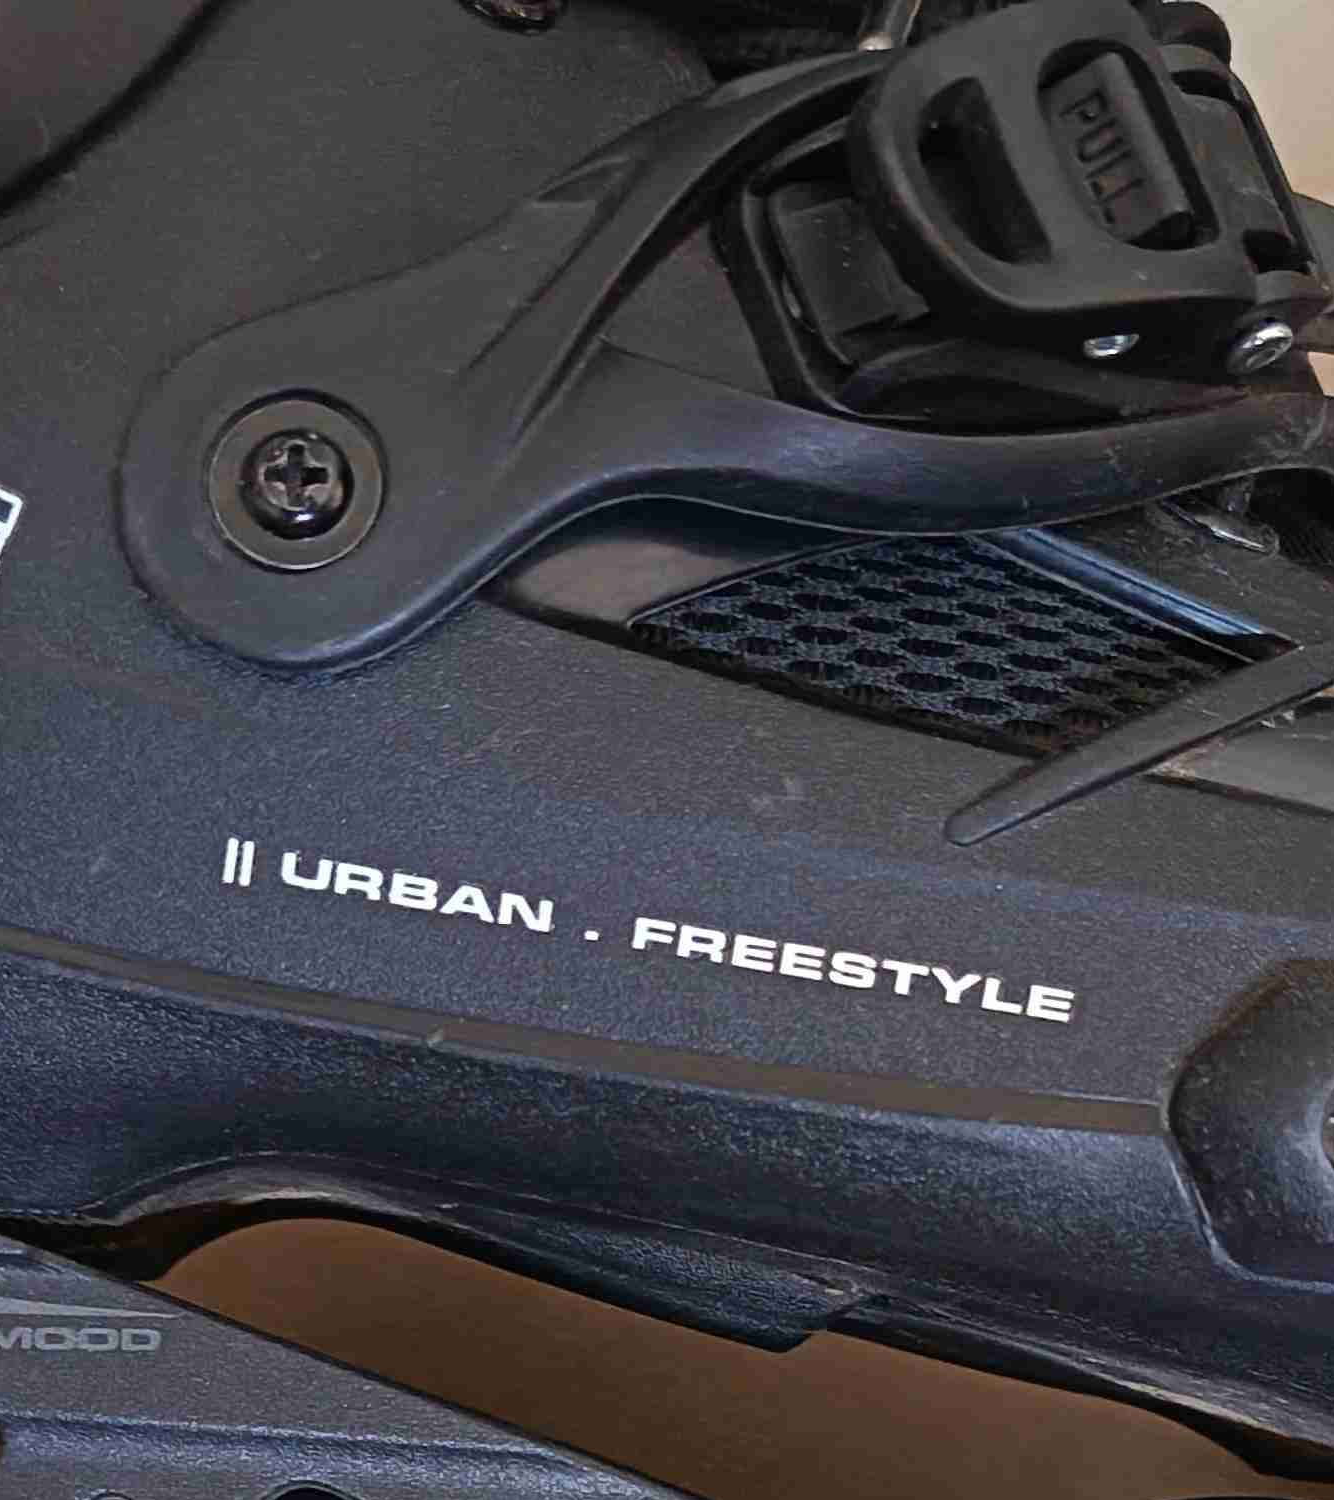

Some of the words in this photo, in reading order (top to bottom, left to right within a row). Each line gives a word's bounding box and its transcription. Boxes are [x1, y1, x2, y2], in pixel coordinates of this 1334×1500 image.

[1059, 88, 1146, 224] PULL
[280, 851, 554, 932] URBAN
[632, 917, 1075, 1024] FREESTYLE
